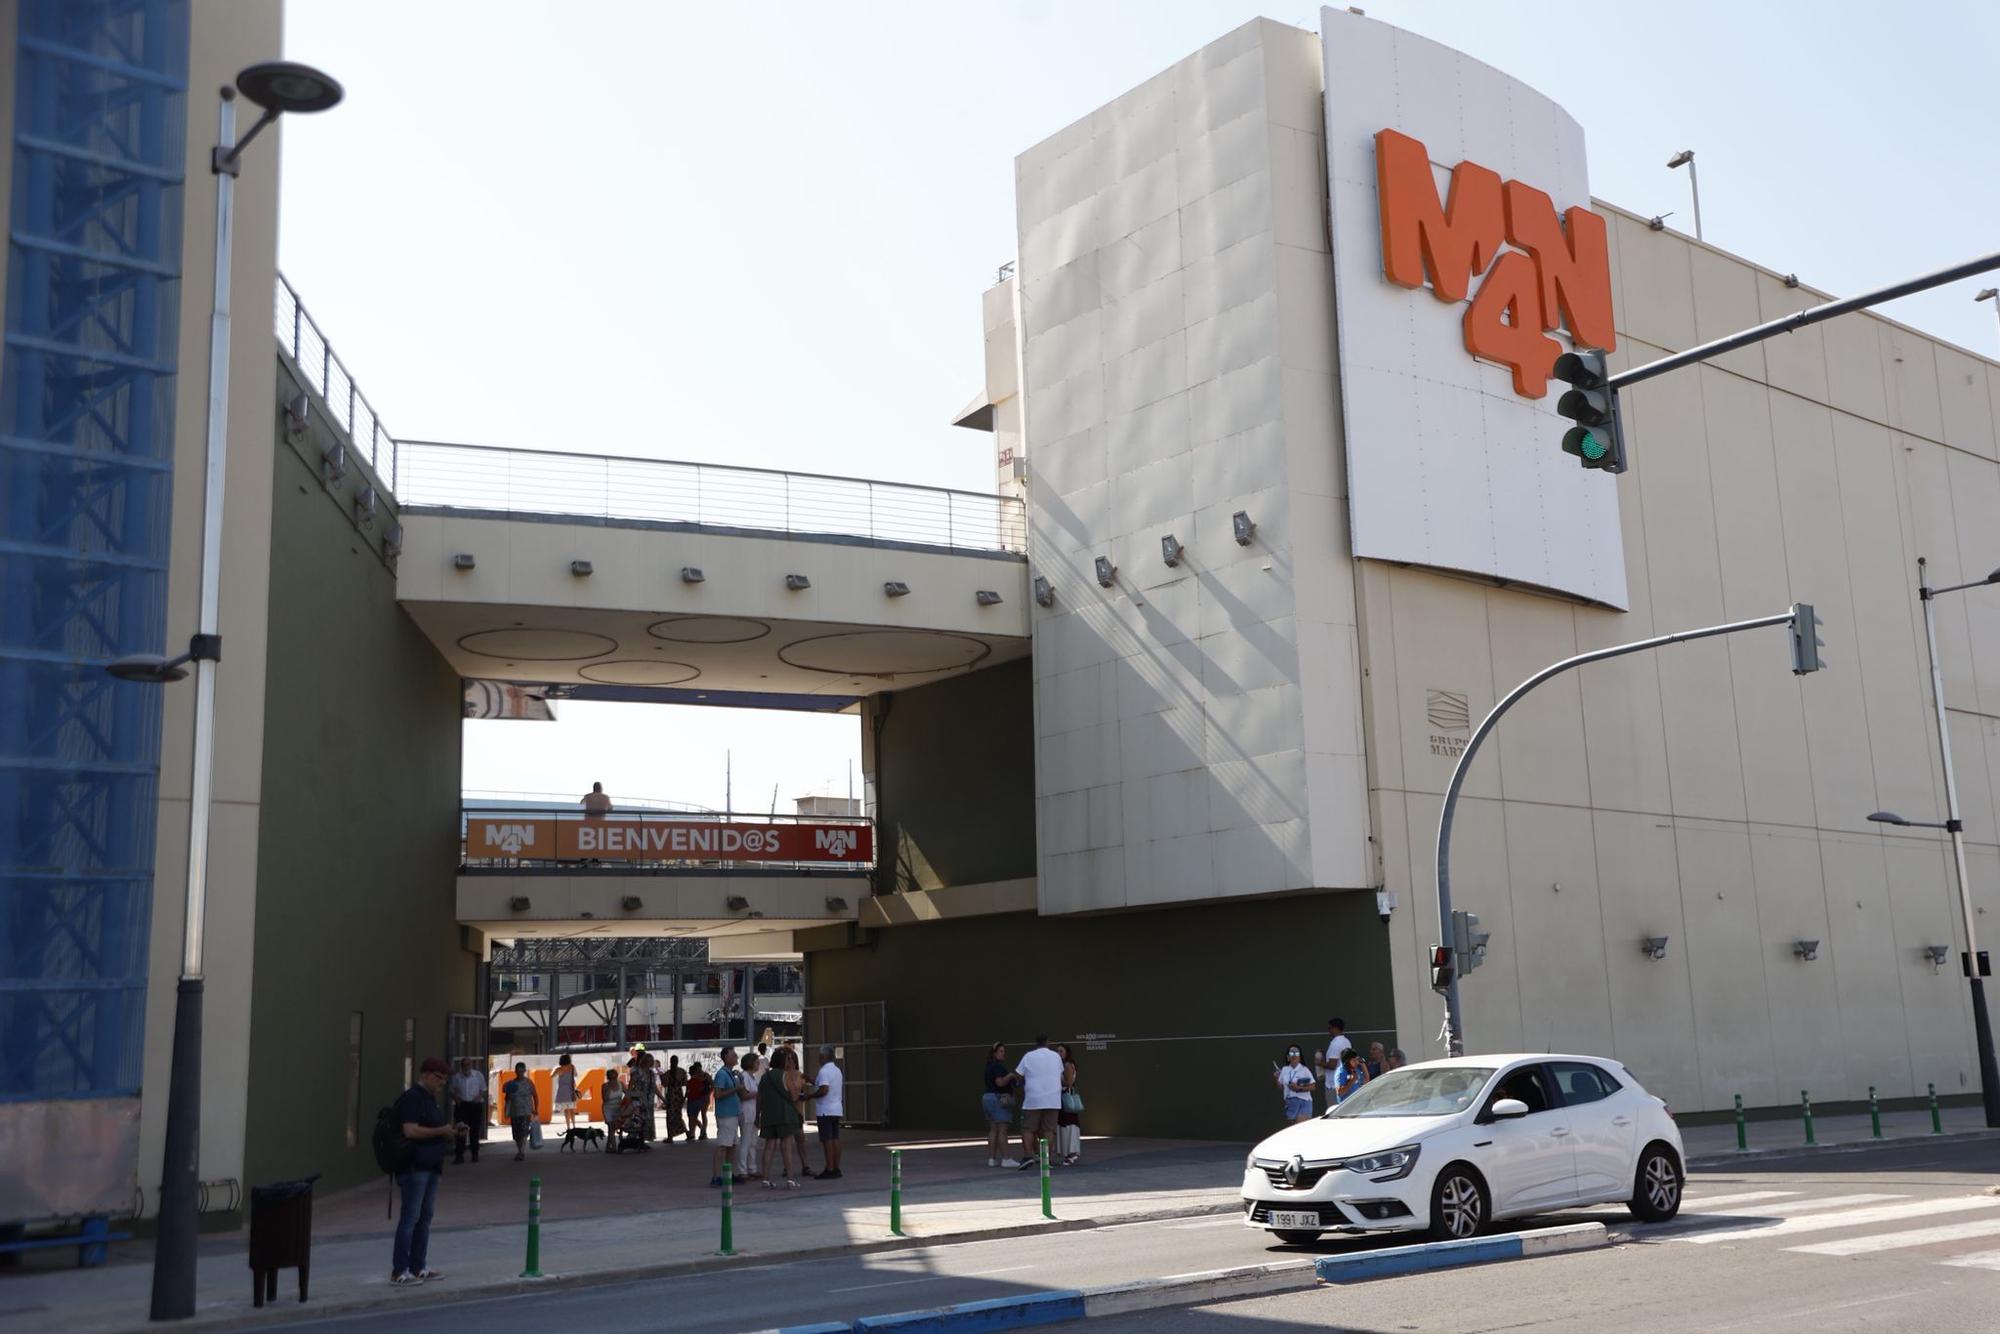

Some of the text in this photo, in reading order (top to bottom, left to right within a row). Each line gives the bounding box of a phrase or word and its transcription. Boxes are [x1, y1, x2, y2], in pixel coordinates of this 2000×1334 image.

[578, 827, 780, 853] BIENVENID@S
[1276, 1214, 1316, 1226] 1991 JXZ
